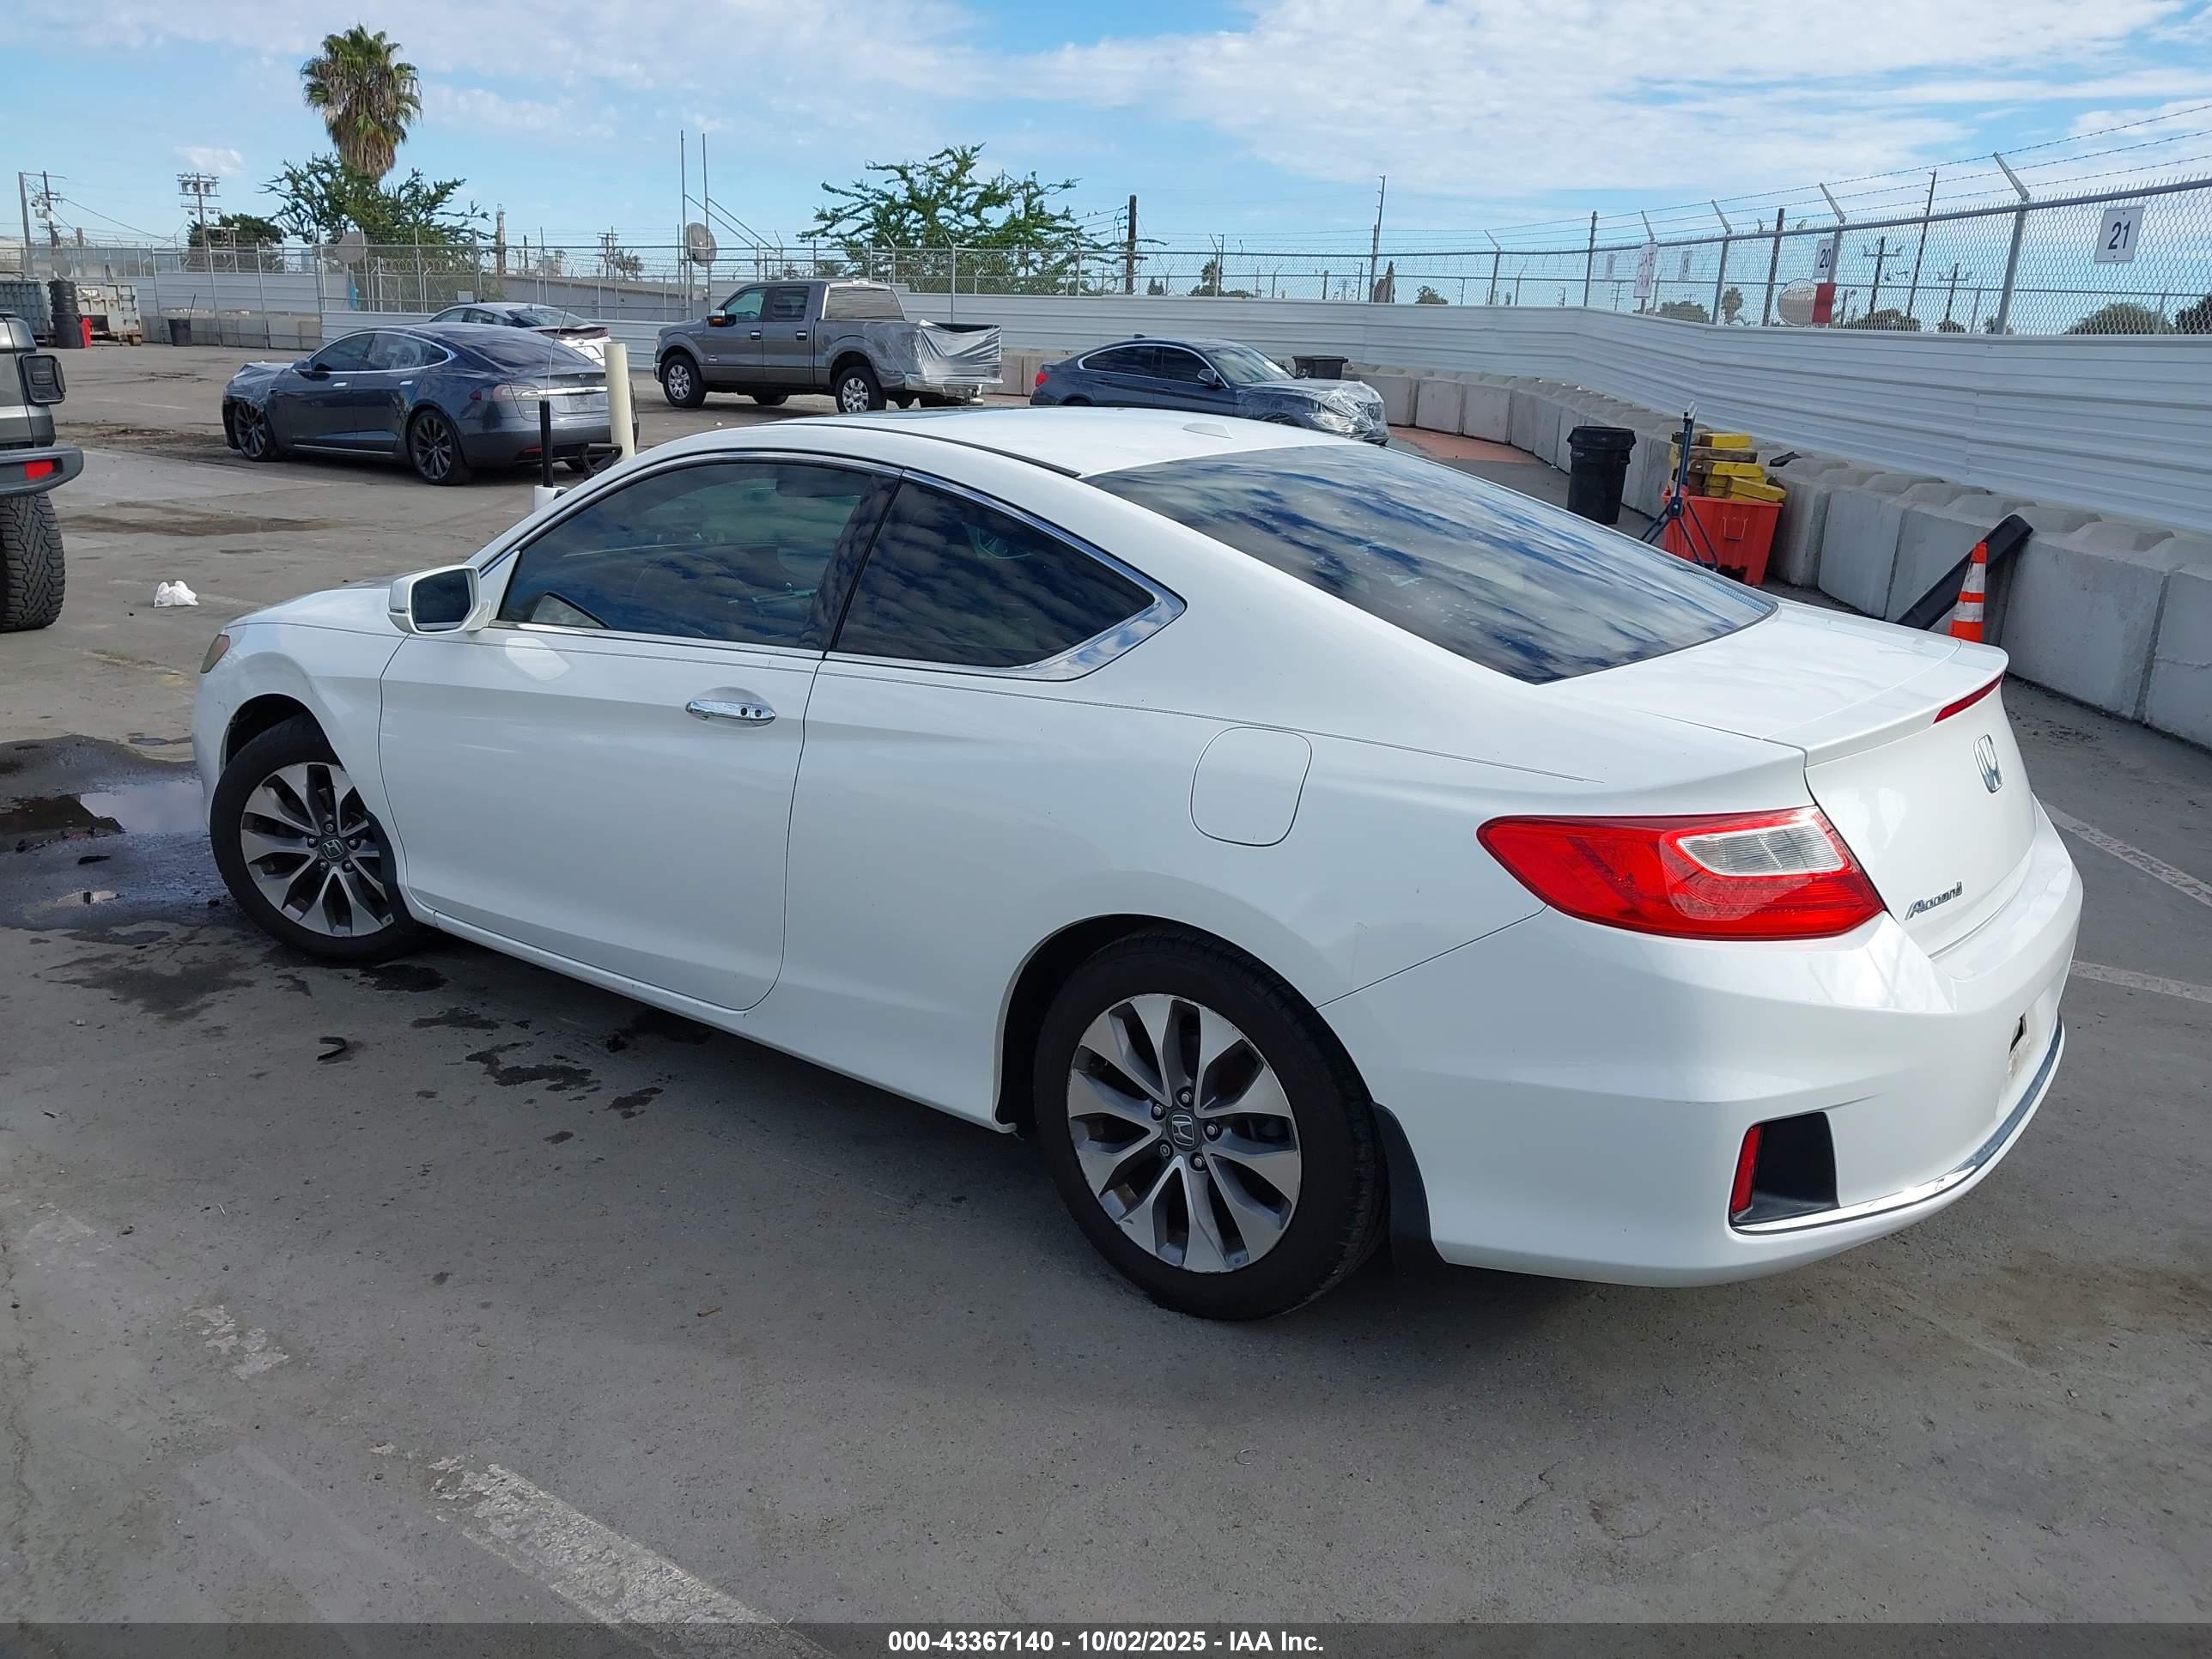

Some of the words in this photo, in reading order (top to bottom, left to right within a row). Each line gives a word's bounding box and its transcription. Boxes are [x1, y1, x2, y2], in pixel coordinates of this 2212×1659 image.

[2107, 220, 2131, 250] 21
[1819, 248, 1832, 269] 20
[1904, 880, 1963, 921] Accord
